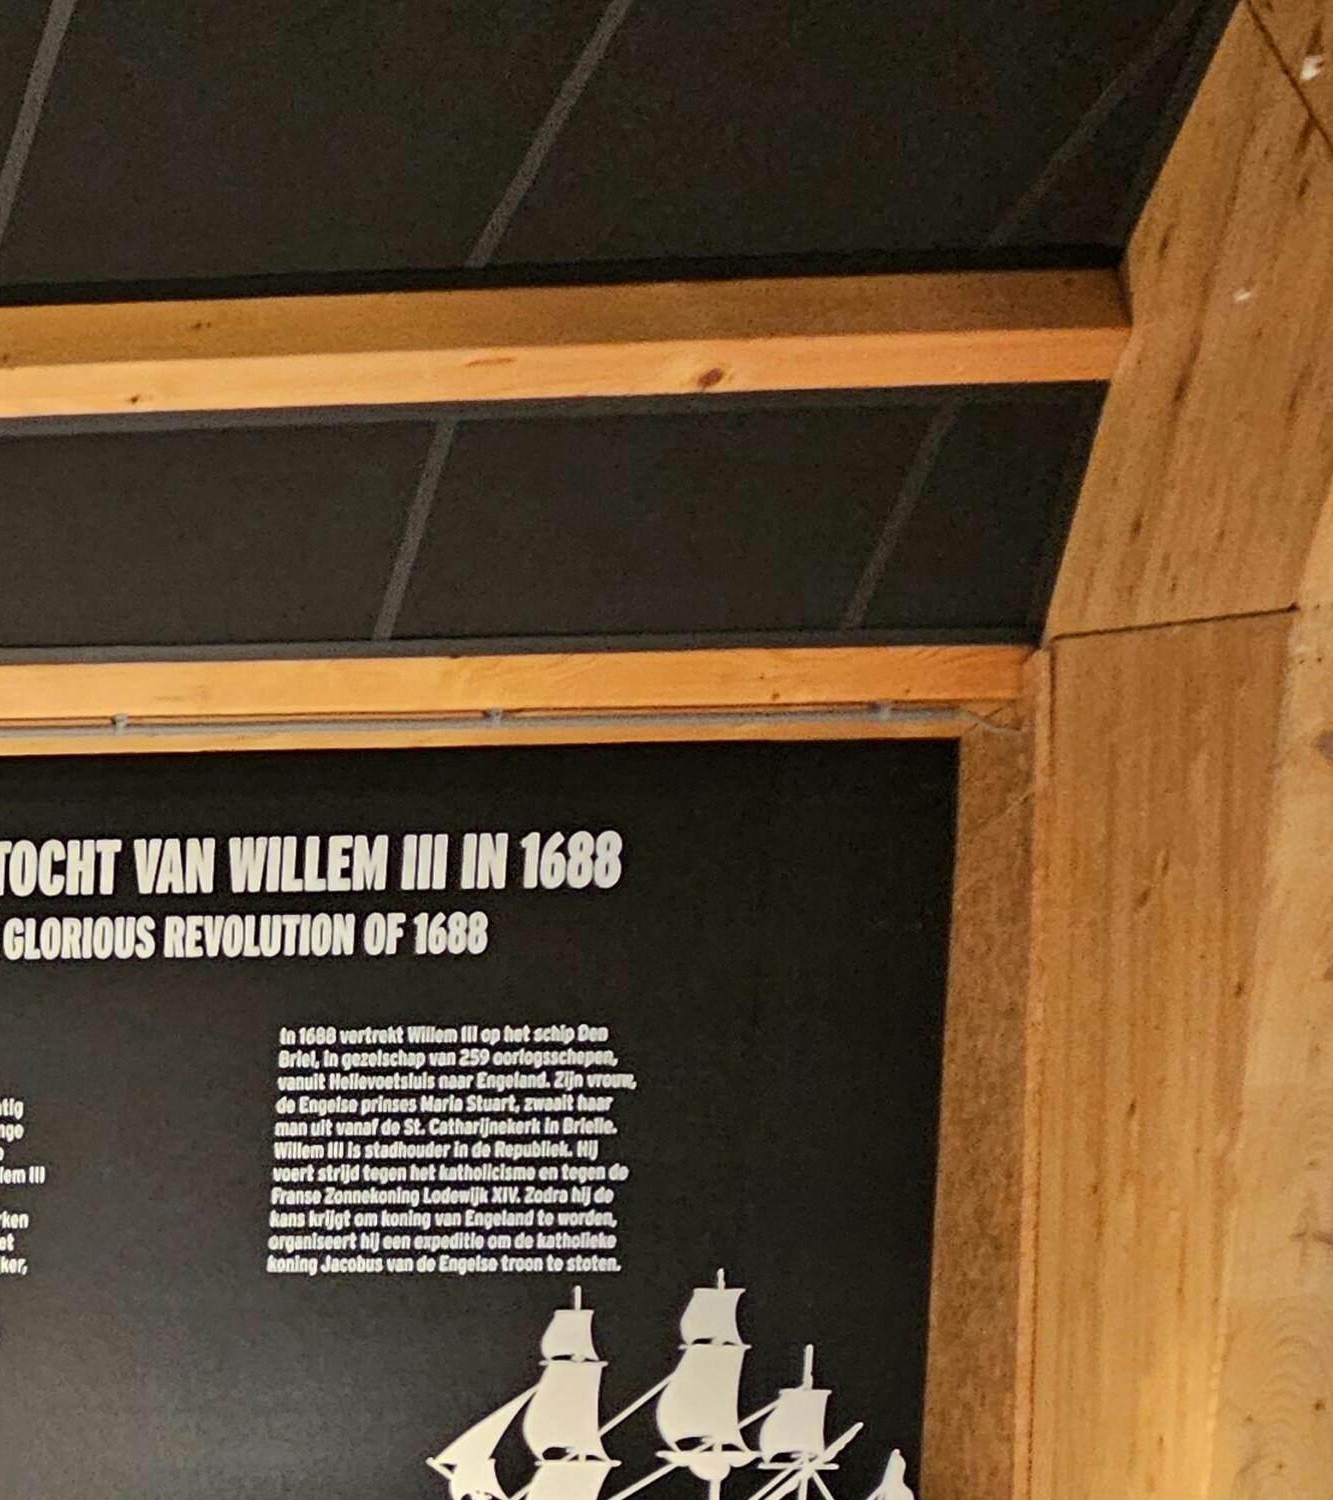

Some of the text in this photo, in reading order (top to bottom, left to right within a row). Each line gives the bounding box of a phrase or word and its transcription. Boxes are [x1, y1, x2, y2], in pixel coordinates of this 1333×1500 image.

[133, 839, 216, 893] VAN
[228, 836, 389, 891] WILLEM
[400, 834, 449, 889] III
[460, 833, 509, 888] IN
[520, 831, 623, 888] 1688
[3, 917, 156, 959] GLORIOUS
[163, 915, 356, 956] REVOLUTION
[363, 913, 406, 955] OF
[413, 912, 488, 954] 1688
[277, 1073, 326, 1090] vanuit
[438, 1074, 474, 1088] naar
[476, 1071, 551, 1091] Engeland.
[553, 1070, 584, 1090] Zijn
[586, 1073, 637, 1089] vrouw,
[274, 1122, 308, 1136] man
[310, 1119, 333, 1136] uit
[335, 1117, 379, 1135] vanaf
[380, 1117, 401, 1135] de
[403, 1117, 426, 1135] St.
[544, 1116, 560, 1134] in
[562, 1116, 618, 1134] Brielle.
[273, 1141, 325, 1159] Willem
[327, 1141, 344, 1158] III
[347, 1141, 361, 1158] is
[453, 1140, 469, 1157] in
[471, 1140, 491, 1158] de
[576, 1140, 599, 1160] Hij
[28, 1165, 46, 1183] III
